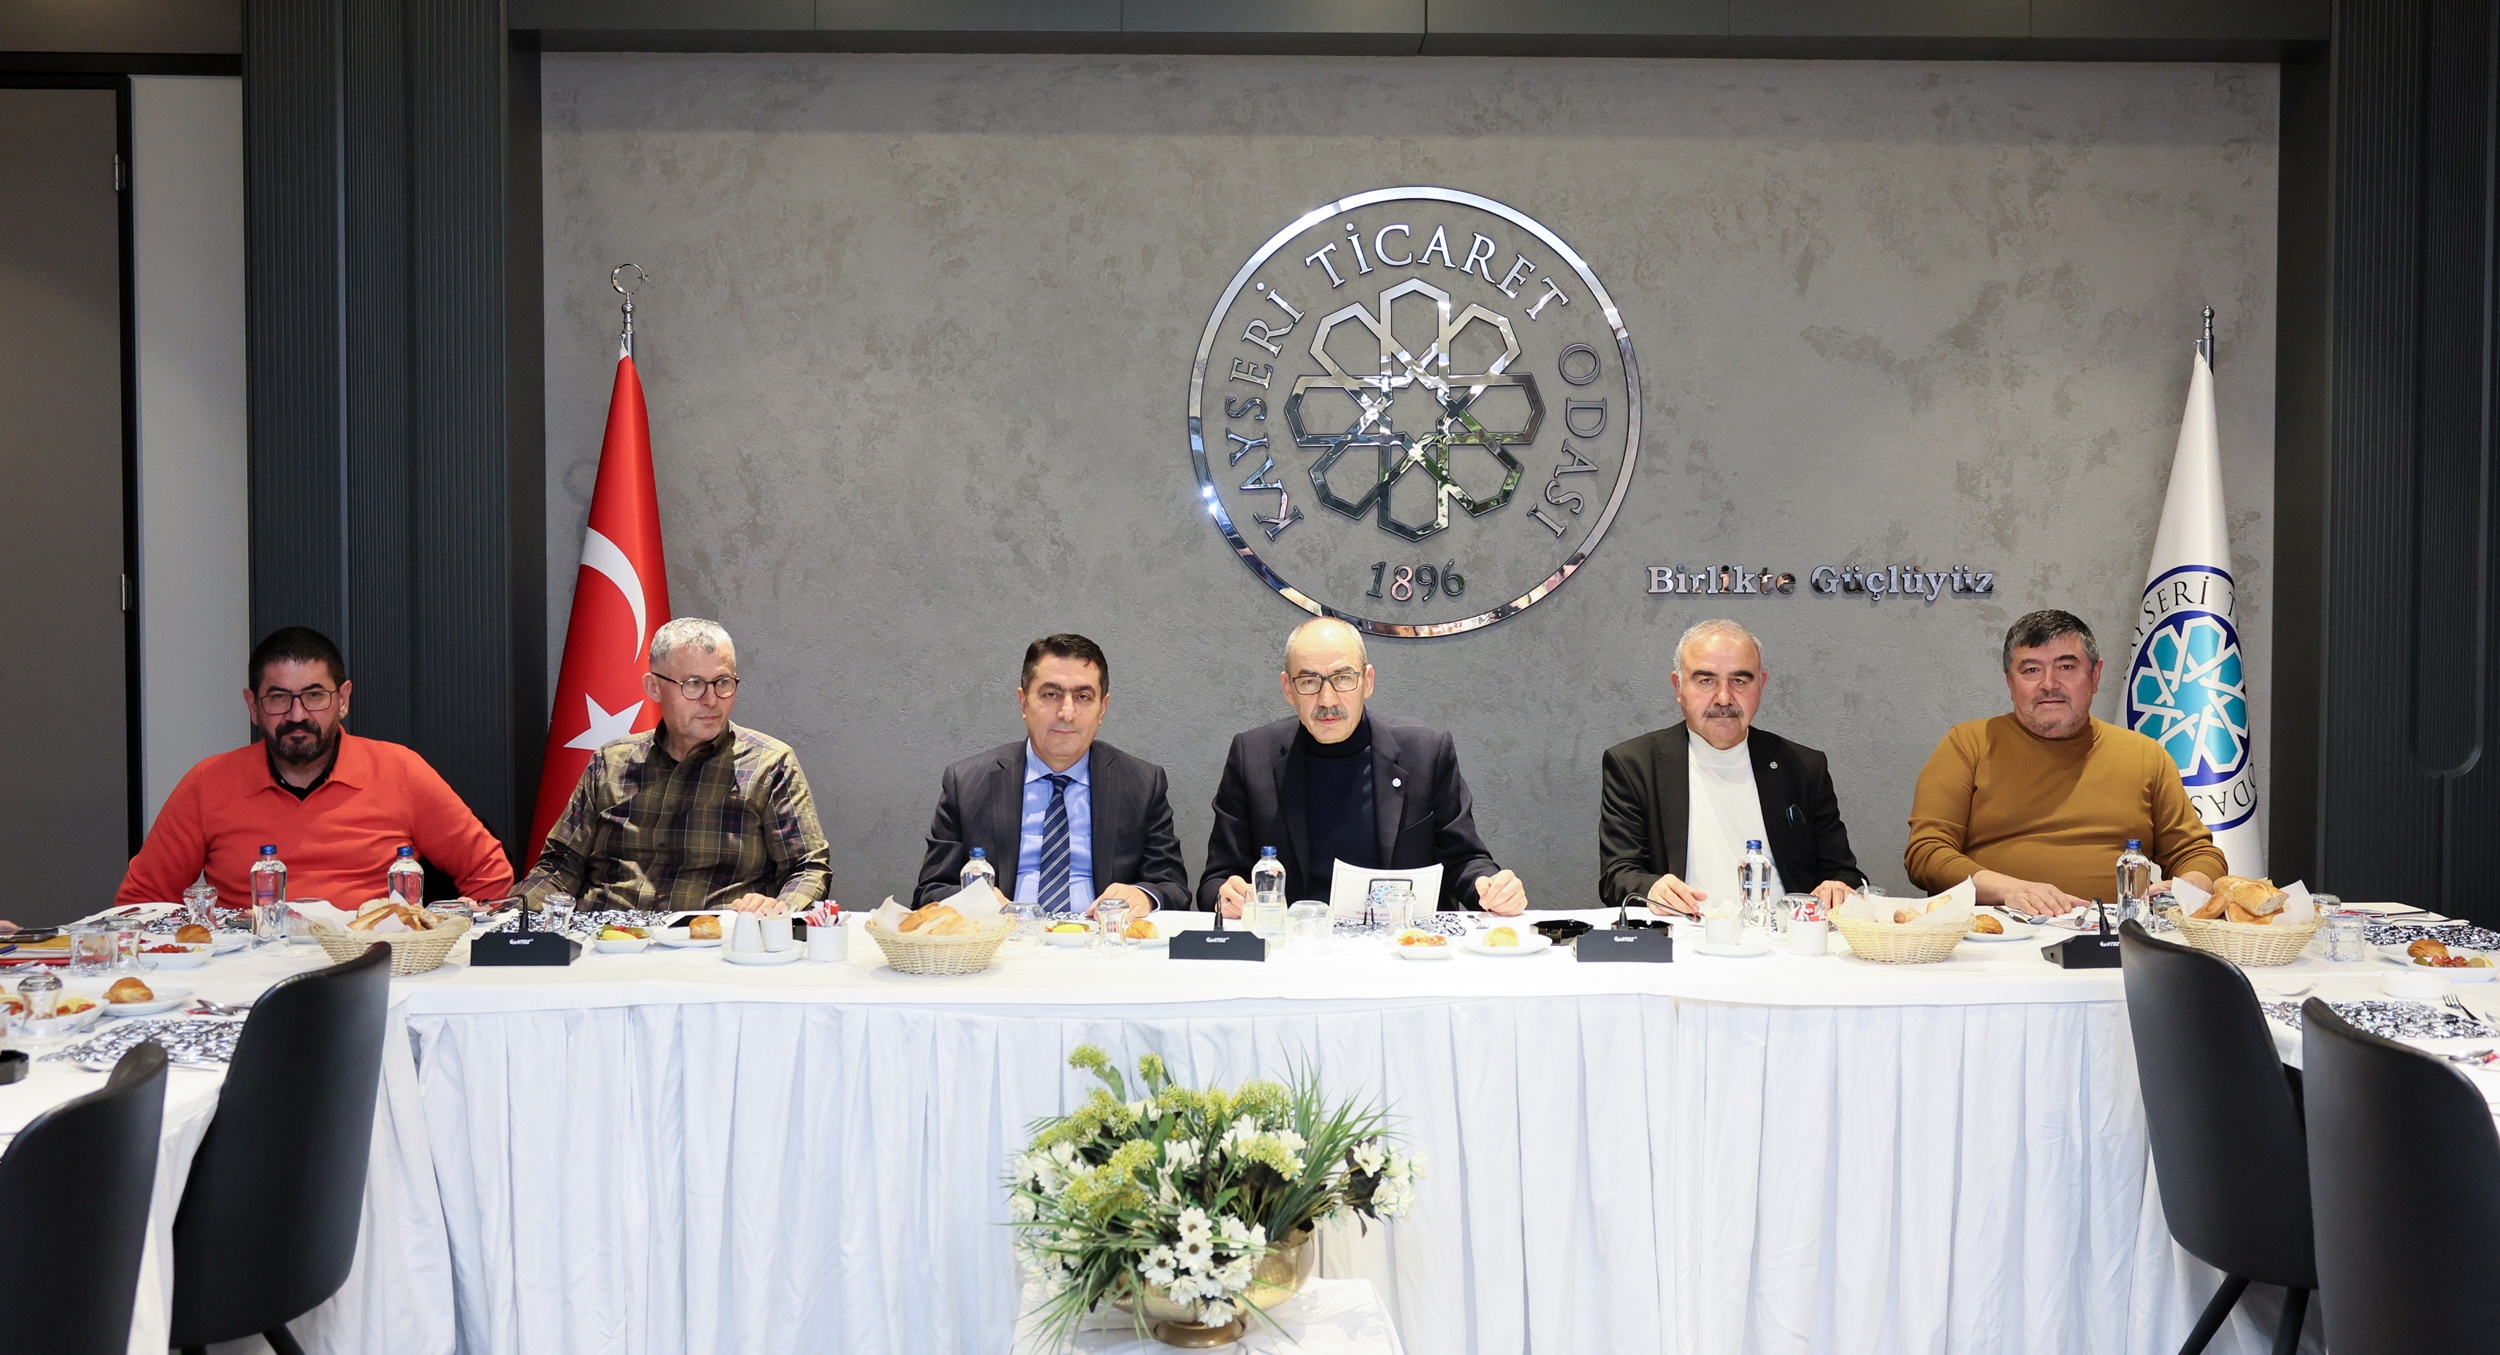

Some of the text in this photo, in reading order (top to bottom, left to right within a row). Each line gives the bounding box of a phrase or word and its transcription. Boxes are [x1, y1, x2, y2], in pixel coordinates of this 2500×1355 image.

[1225, 222, 1608, 541] KAYSERİ TİCARET ODASI
[1366, 559, 1465, 602] 1896
[1647, 564, 1995, 601] Birlikte Güçlüyüz
[2124, 575, 2209, 680] YSERİ
[2190, 762, 2256, 820] ODAS
